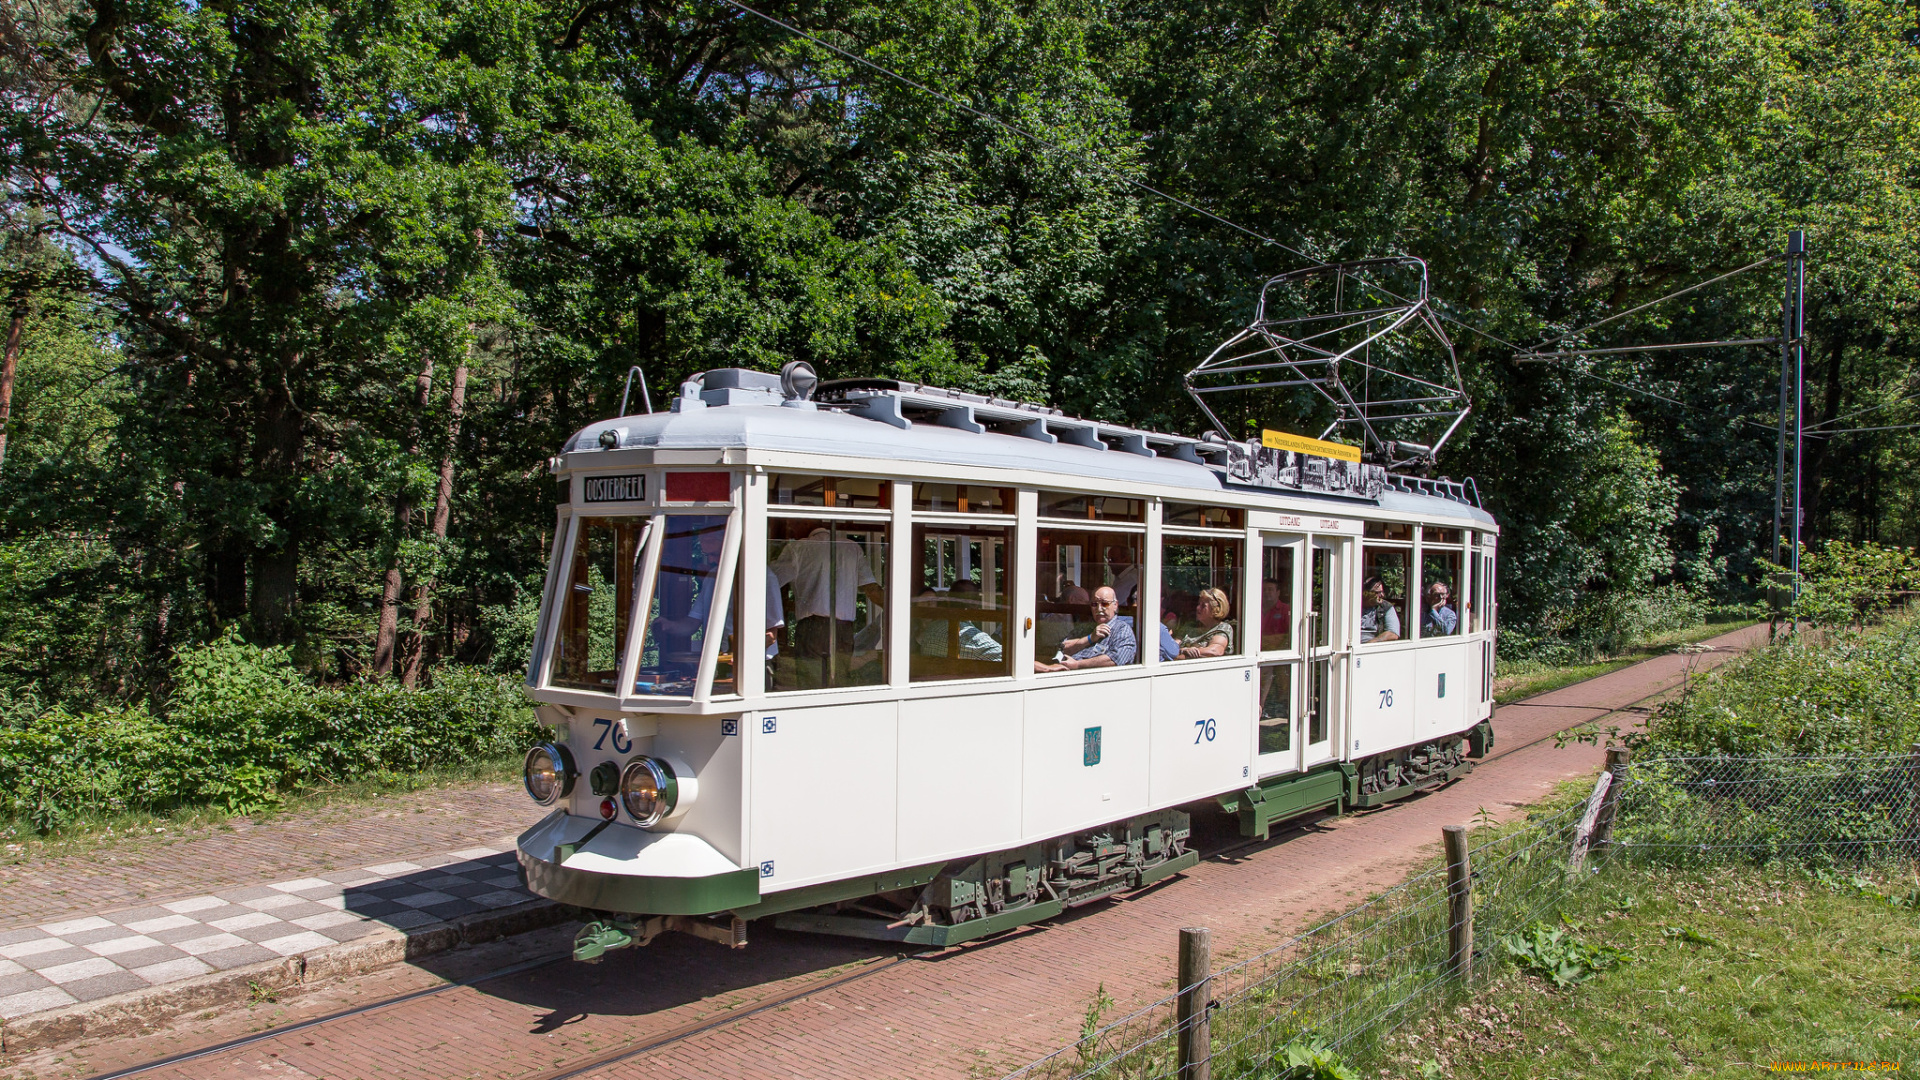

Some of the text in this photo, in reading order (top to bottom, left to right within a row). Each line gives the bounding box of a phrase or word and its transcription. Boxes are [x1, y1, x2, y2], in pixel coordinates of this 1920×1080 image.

[586, 476, 645, 500] OOSTERBEEK
[1279, 516, 1301, 527] UITGANG
[1319, 519, 1340, 530] UITGANG
[1378, 688, 1394, 709] 76
[592, 717, 633, 754] 76
[1194, 718, 1217, 745] 76
